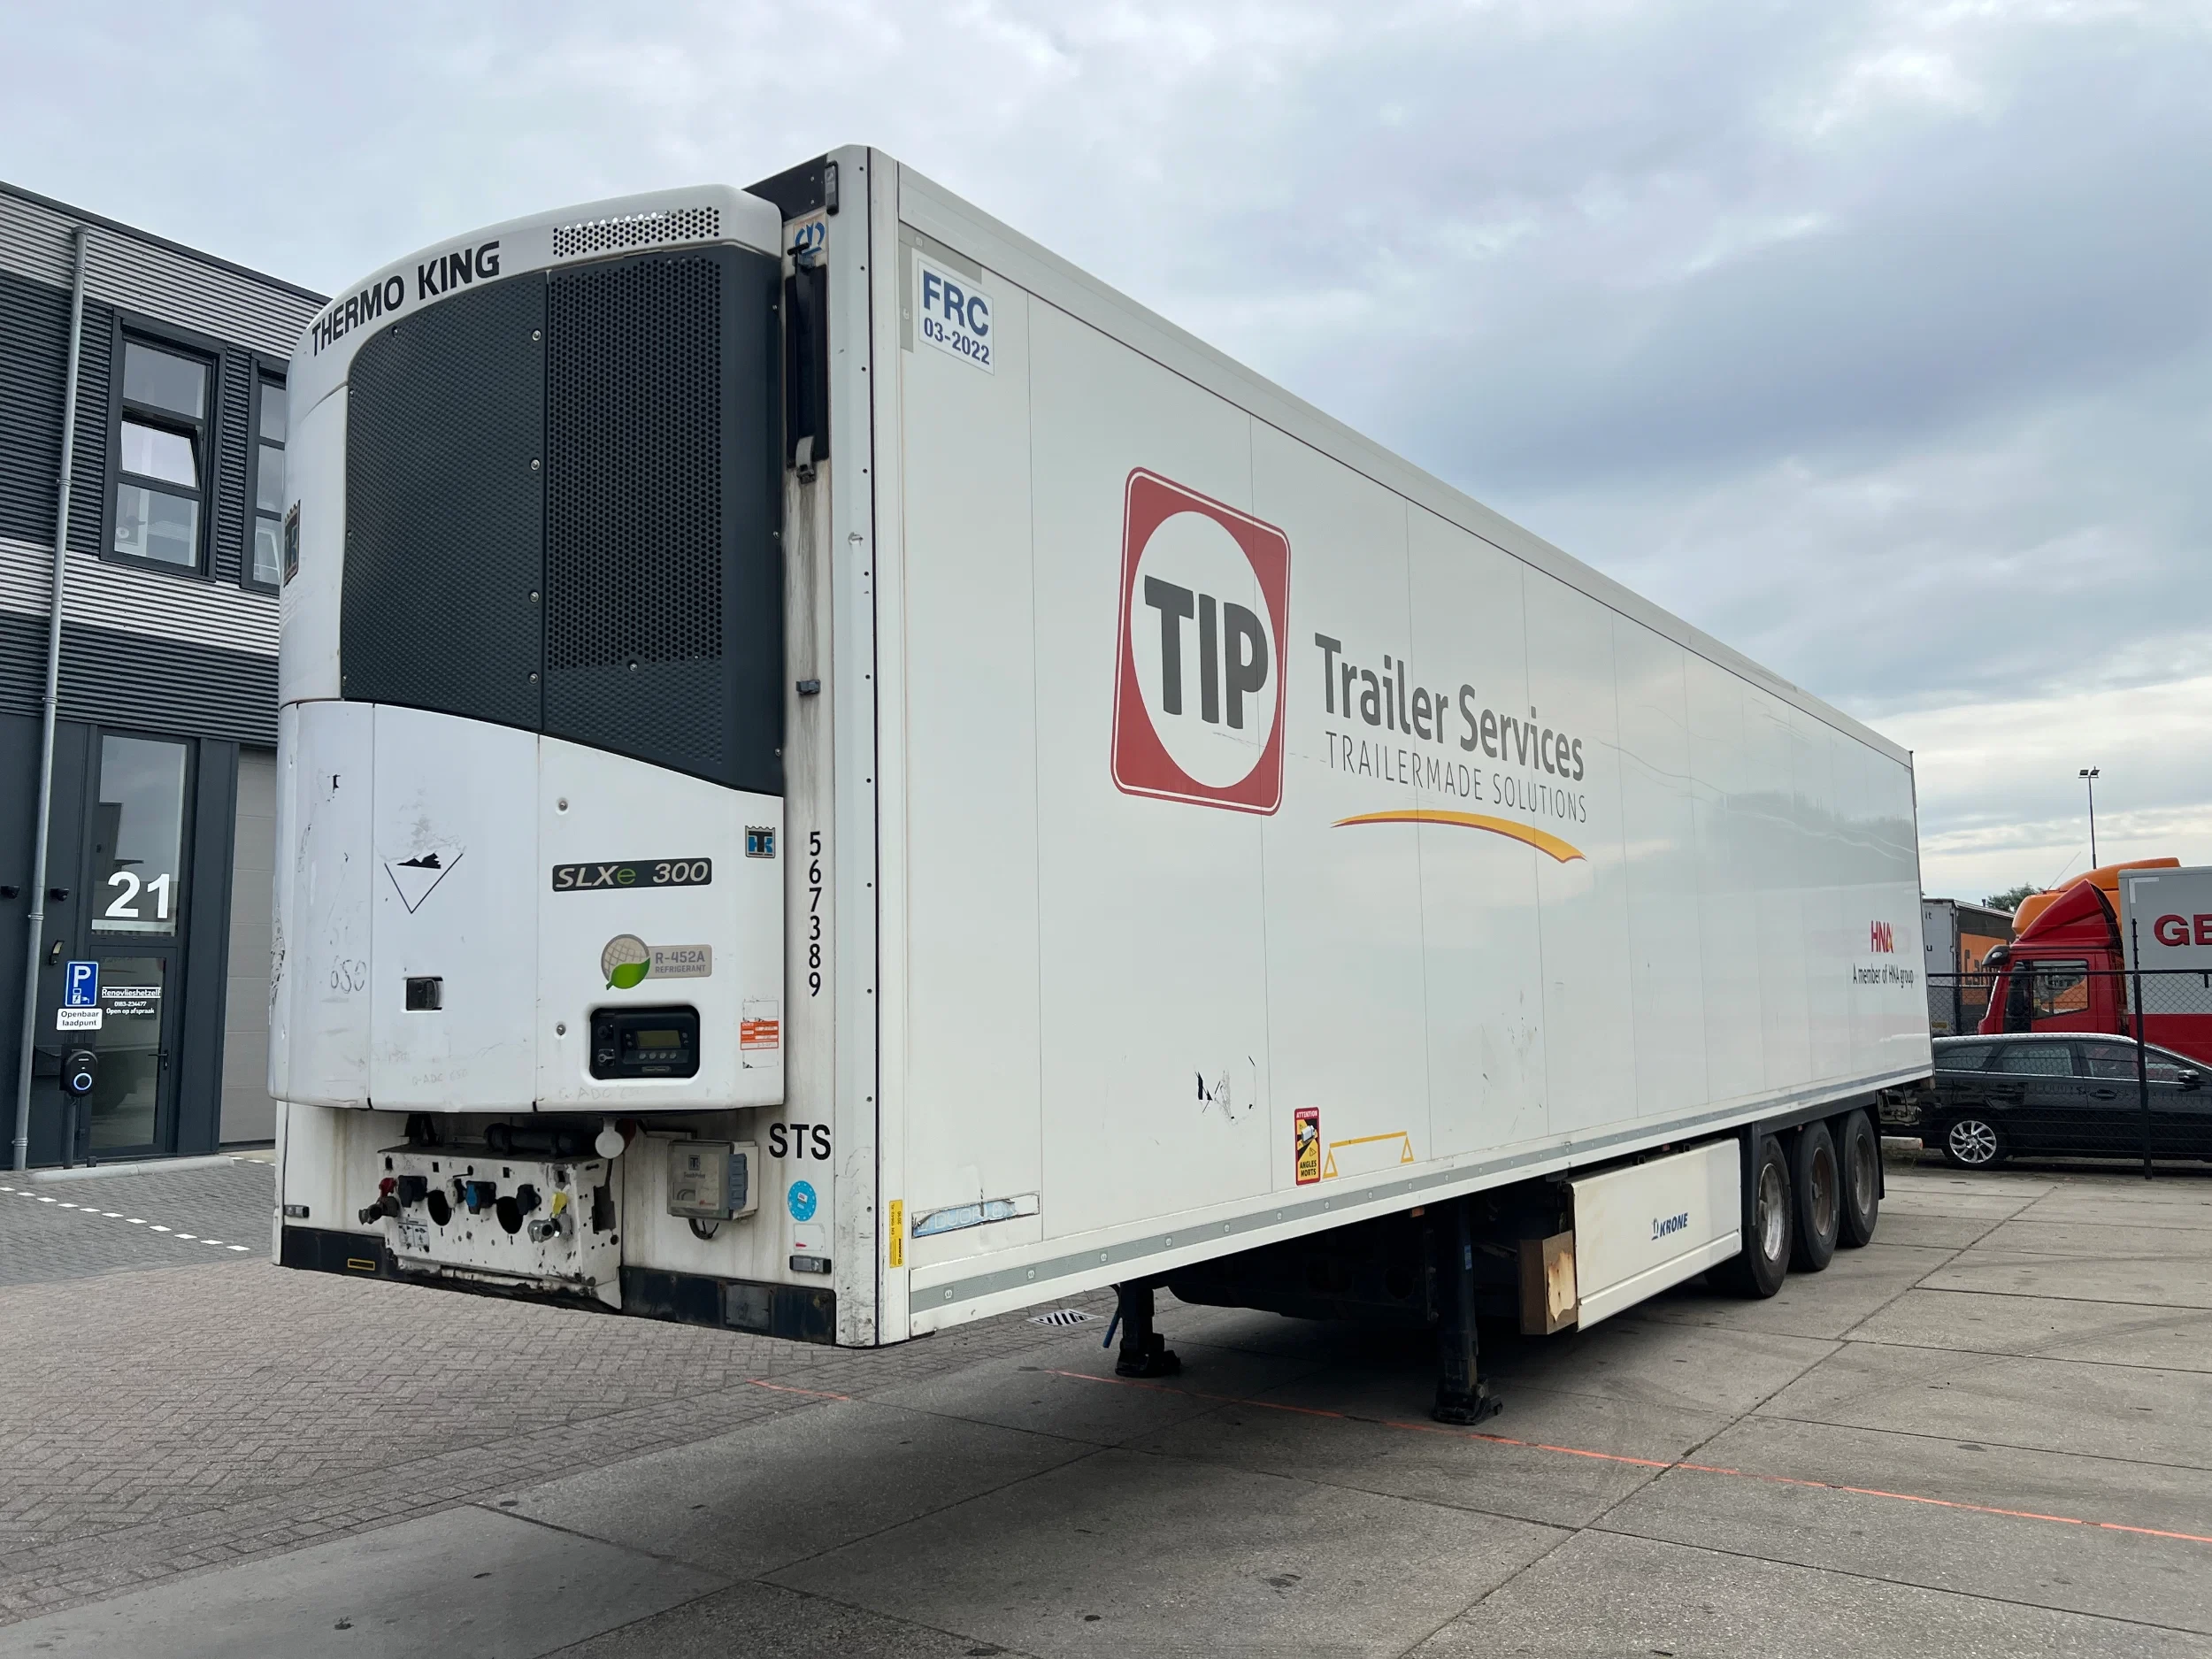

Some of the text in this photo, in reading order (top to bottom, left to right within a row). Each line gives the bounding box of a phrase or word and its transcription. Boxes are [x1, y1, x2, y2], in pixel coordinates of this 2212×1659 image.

[312, 241, 500, 357] THERMO KING
[923, 270, 989, 337] FRC
[924, 317, 990, 365] 03-2022
[1144, 575, 1269, 730] TIP
[1315, 633, 1585, 782] Trailer Services
[1325, 730, 1586, 824] TRAILERMADE SOLUTIONS
[556, 861, 708, 888] SLXe 300
[104, 871, 170, 919] 21
[809, 831, 822, 997] 567389
[655, 950, 706, 964] R-452A
[655, 964, 706, 974] REFRIGERANT
[73, 965, 91, 988] P
[1853, 962, 1915, 989] A member of HNA group
[60, 1010, 100, 1019] Openbaar
[1296, 1110, 1318, 1118] ATTENTION
[768, 1123, 832, 1161] STS
[1300, 1159, 1317, 1169] ANGLES
[1300, 1168, 1317, 1178] MORTS
[1660, 1212, 1689, 1237] KRONE
